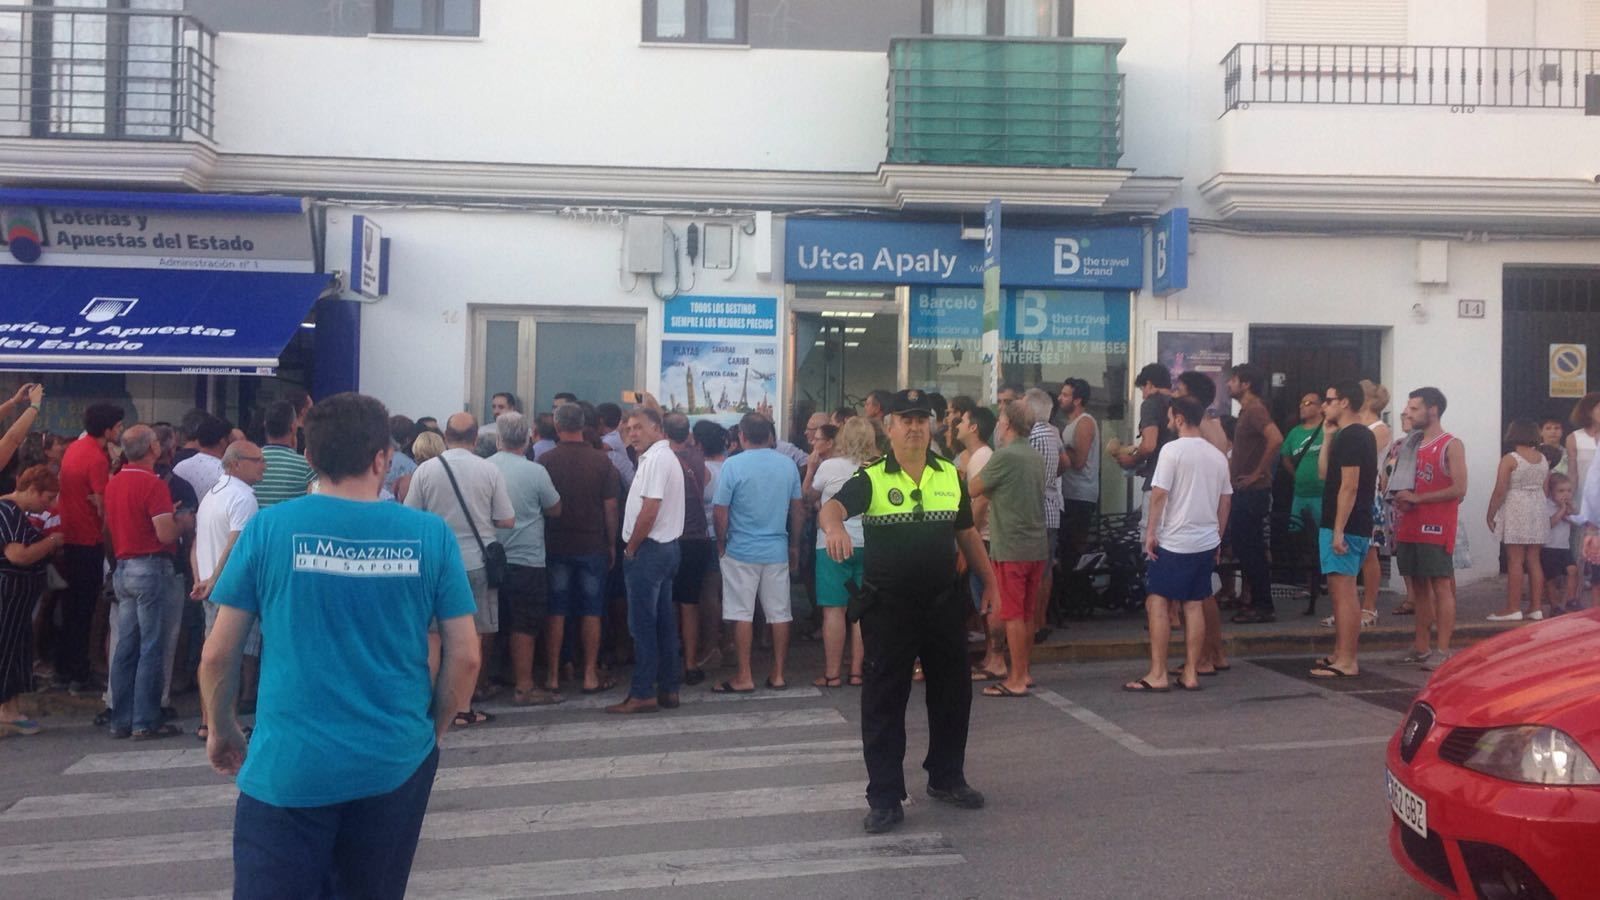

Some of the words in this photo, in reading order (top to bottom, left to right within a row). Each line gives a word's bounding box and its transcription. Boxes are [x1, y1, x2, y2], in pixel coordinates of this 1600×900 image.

[137, 214, 148, 231] y
[57, 231, 147, 249] Apuestas
[153, 233, 182, 249] del
[187, 235, 254, 251] Estado
[159, 258, 235, 268] Administración
[798, 245, 864, 270] Utca
[872, 247, 957, 278] Apaly
[1054, 238, 1080, 275] B
[1083, 257, 1100, 266] the
[1101, 257, 1129, 267] travel
[1083, 267, 1113, 276] brand
[691, 302, 712, 313] TODOS
[713, 303, 725, 314] LOS
[726, 303, 756, 314] DESTINOS
[920, 294, 977, 309] Barceló
[1015, 290, 1048, 335] B
[1464, 303, 1480, 315] 14
[671, 316, 699, 328] SIEMPRE
[699, 317, 704, 327] A
[705, 317, 717, 328] LOS
[717, 317, 745, 329] MEJORES
[747, 318, 774, 330] PRECIOS
[1052, 313, 1073, 324] the
[1074, 313, 1110, 325] travel
[68, 327, 93, 337] y
[97, 325, 237, 338] Apuestas
[1052, 325, 1089, 336] brand
[38, 340, 144, 351] Estado
[672, 346, 700, 357] PLAYAS
[712, 346, 736, 354] CANARIAS
[966, 339, 980, 351] TU
[1018, 340, 1054, 352] HASTA
[1057, 341, 1071, 353] EN
[1076, 342, 1088, 353] 12
[1091, 342, 1127, 354] MESES
[728, 357, 750, 366] CARIBE
[299, 542, 311, 554] IL
[316, 539, 413, 560] MAGAZZINO
[299, 558, 328, 567] DEI
[343, 561, 412, 572] SAPORI
